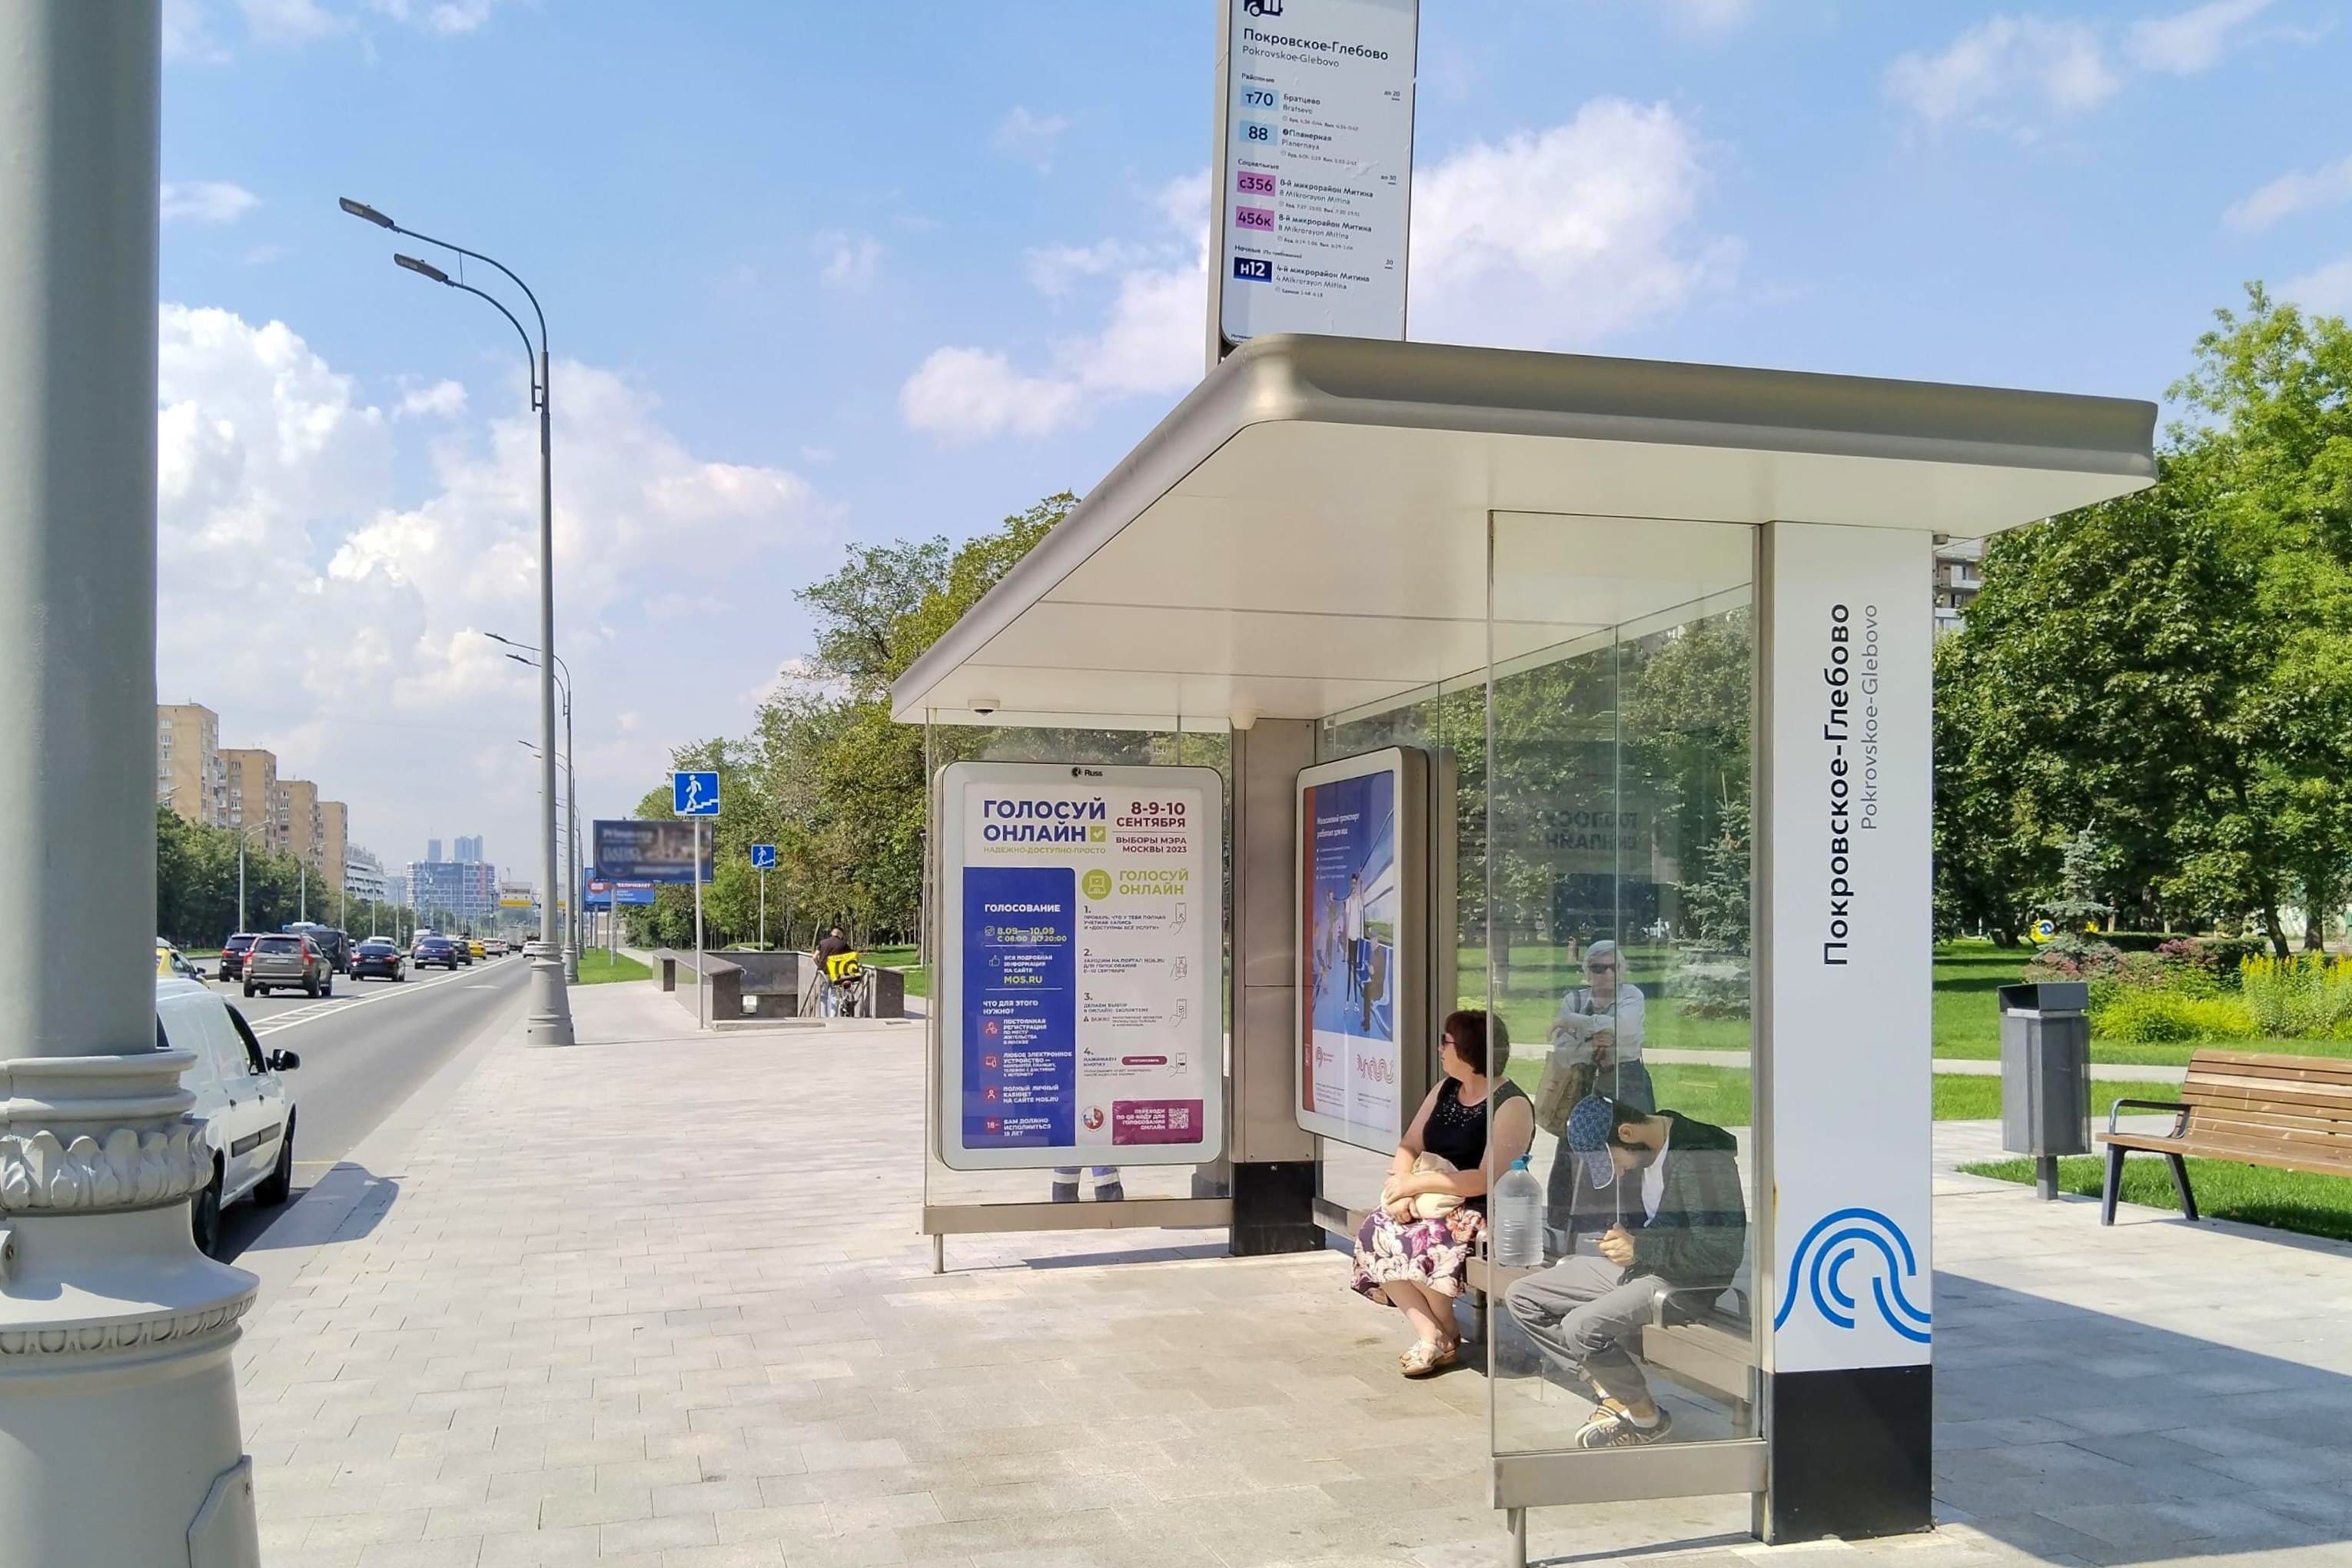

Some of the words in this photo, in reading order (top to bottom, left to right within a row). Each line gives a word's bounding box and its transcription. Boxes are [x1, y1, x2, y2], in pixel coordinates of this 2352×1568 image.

[1244, 28, 1389, 61] Покровское-Глебово
[1242, 45, 1340, 68] Pokrovskoe-Glebovo
[1246, 91, 1274, 106] т70
[1284, 93, 1321, 106] Братцево
[1283, 104, 1314, 115] Bratsevo
[1248, 125, 1269, 141] 88
[1289, 129, 1333, 141] Планерная
[1281, 138, 1321, 151] Planernaya
[1239, 177, 1273, 191] с356
[1294, 182, 1342, 194] микрорайон
[1344, 188, 1374, 198] Митина
[1285, 191, 1326, 202] Mikrorayon
[1327, 196, 1350, 205] Mitina
[1238, 211, 1271, 228] 456к
[1292, 218, 1340, 228] микрорайон
[1341, 221, 1372, 233] Митина
[1284, 225, 1324, 237] Mikrorayon
[1325, 230, 1349, 240] Mitina
[1290, 267, 1338, 279] микрорайон
[1340, 271, 1370, 283] Митина
[1281, 276, 1323, 287] Mikrorayon
[1324, 281, 1347, 290] Mitina
[1860, 604, 1878, 831] Pokrovskoe-Glebovo
[1823, 603, 1855, 965] Покровское-Глебово
[984, 796, 1106, 820] ГОЛОСУЙ
[1131, 802, 1186, 816] 8-9-10
[1116, 817, 1186, 828] СЕНТЯБРЯ
[983, 821, 1086, 842] ОНЛАЙН
[1119, 868, 1189, 882] ГОЛОСУЙ
[1119, 882, 1184, 895] ОНЛАЙН
[985, 904, 1061, 912] ГОЛОСОВАНИЕ
[1084, 905, 1091, 914] 1.
[1084, 948, 1093, 957] 2.
[1004, 975, 1043, 984] MOS.RU
[1084, 992, 1093, 1001] 3.
[1084, 1047, 1094, 1055] 4.
